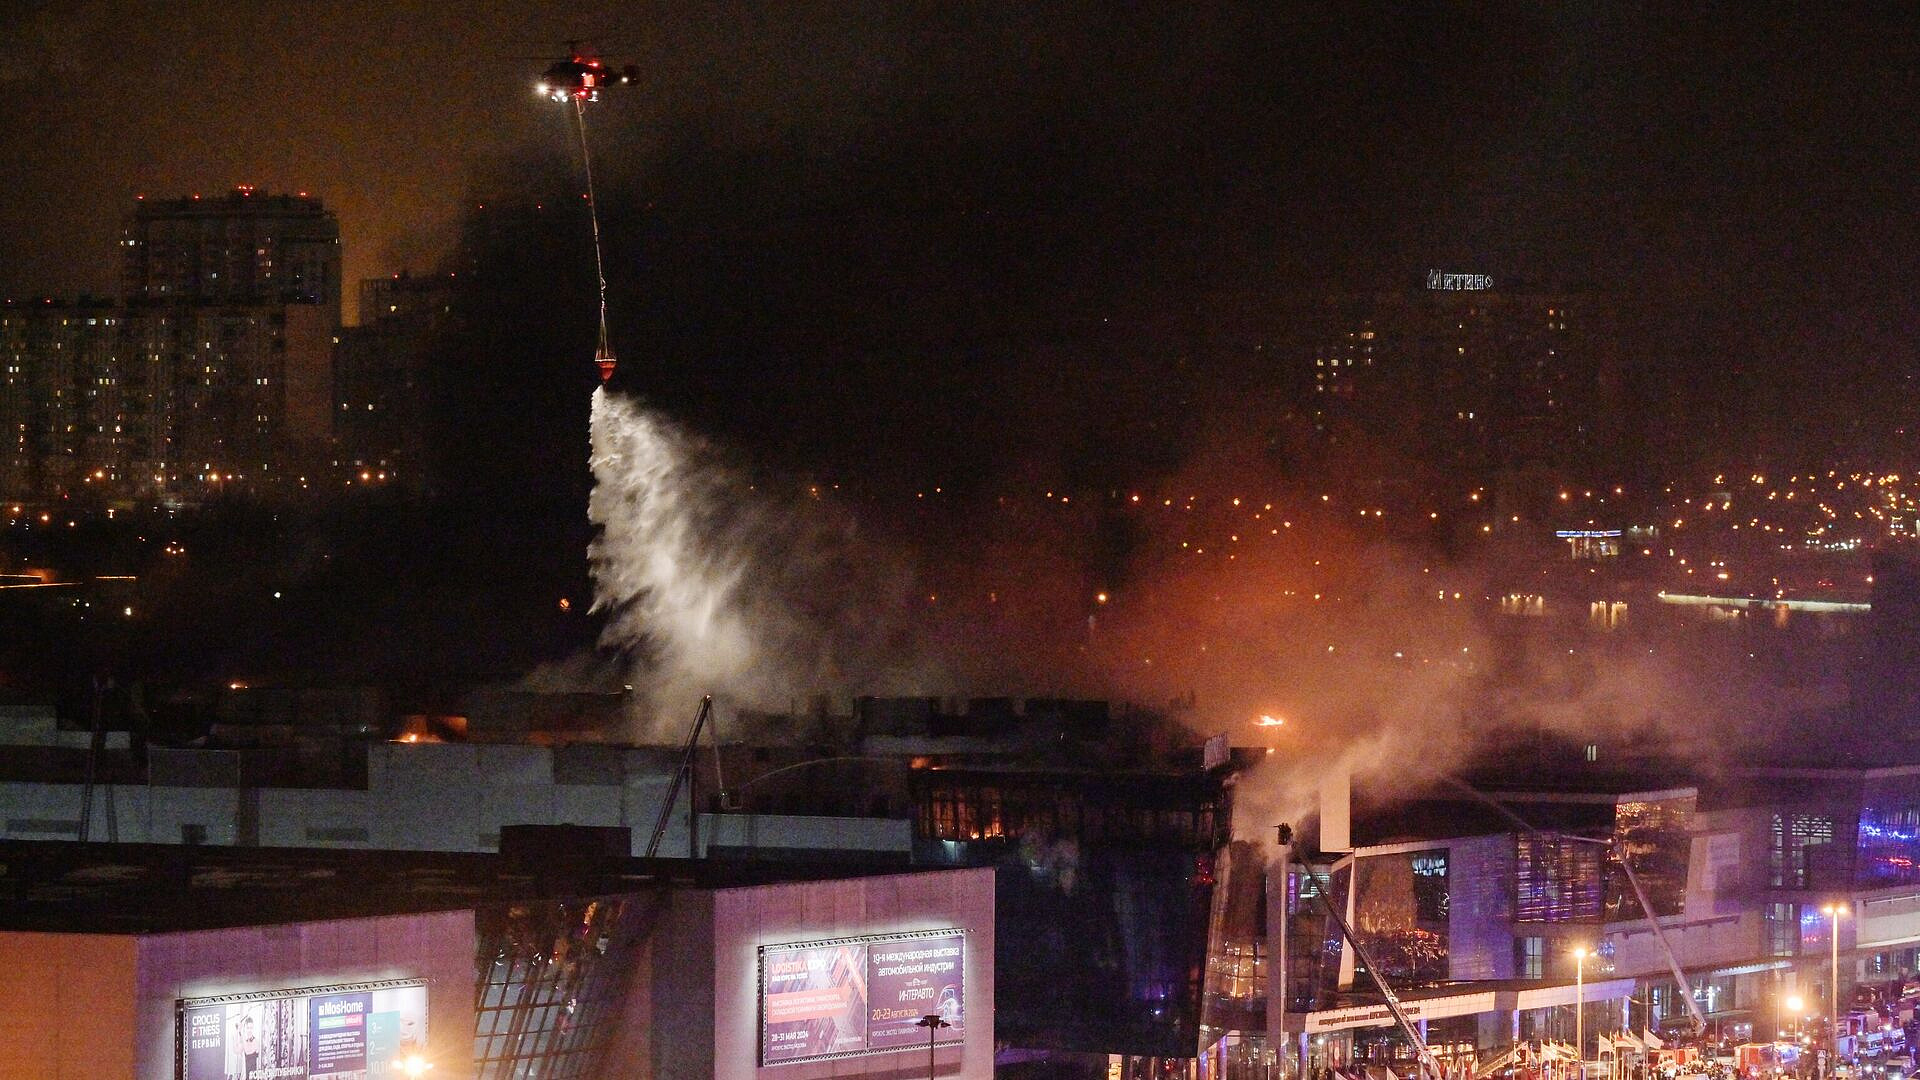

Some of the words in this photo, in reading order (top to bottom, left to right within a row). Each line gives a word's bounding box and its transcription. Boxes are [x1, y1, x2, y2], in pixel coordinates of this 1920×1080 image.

[899, 987, 935, 1001] ИНТЕРАВТО
[324, 1000, 364, 1015] MosHome
[872, 1008, 891, 1020] 20-23
[192, 1013, 220, 1026] CROCUS
[192, 1035, 221, 1049] ПЕРВЫЙ
